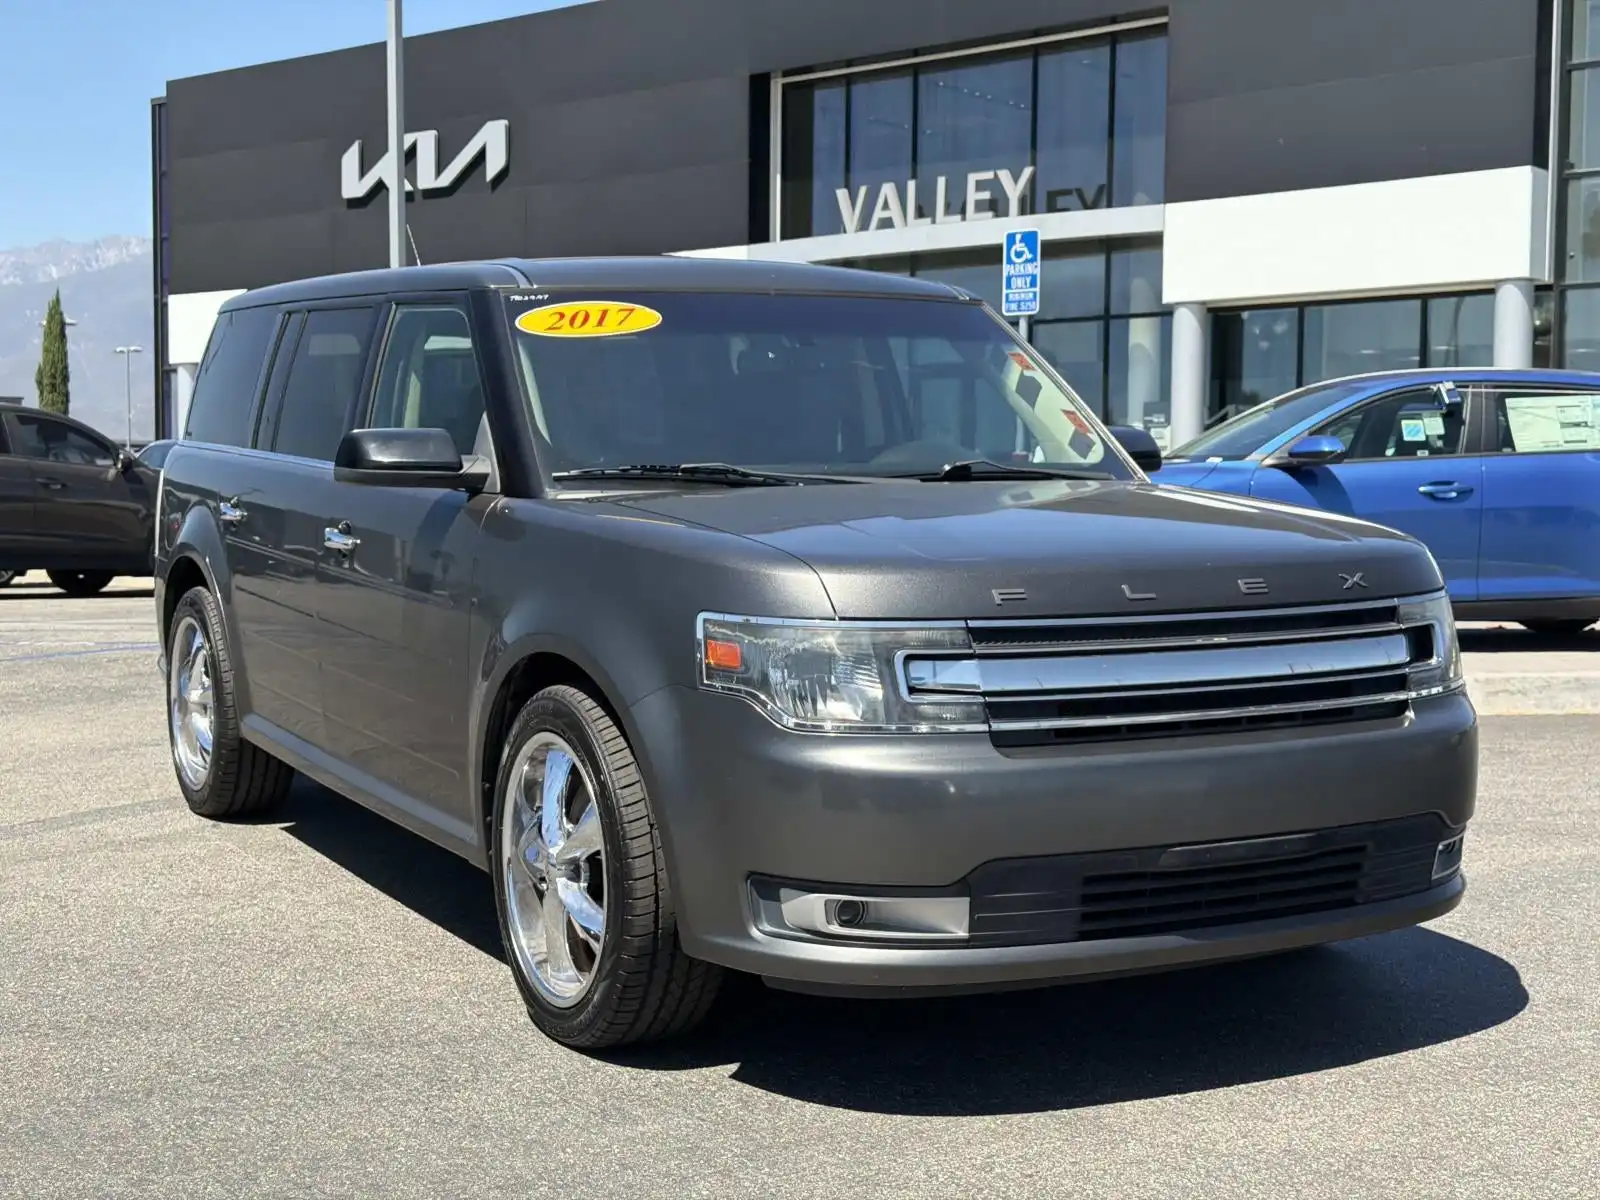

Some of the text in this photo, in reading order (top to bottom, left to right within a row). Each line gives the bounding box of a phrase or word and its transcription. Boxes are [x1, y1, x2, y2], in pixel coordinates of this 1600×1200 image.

[835, 166, 1034, 234] VALLEY
[1004, 262, 1039, 276] PARKING
[1010, 276, 1032, 290] ONLY
[543, 307, 636, 331] 2017
[991, 572, 1369, 606] FLEX
